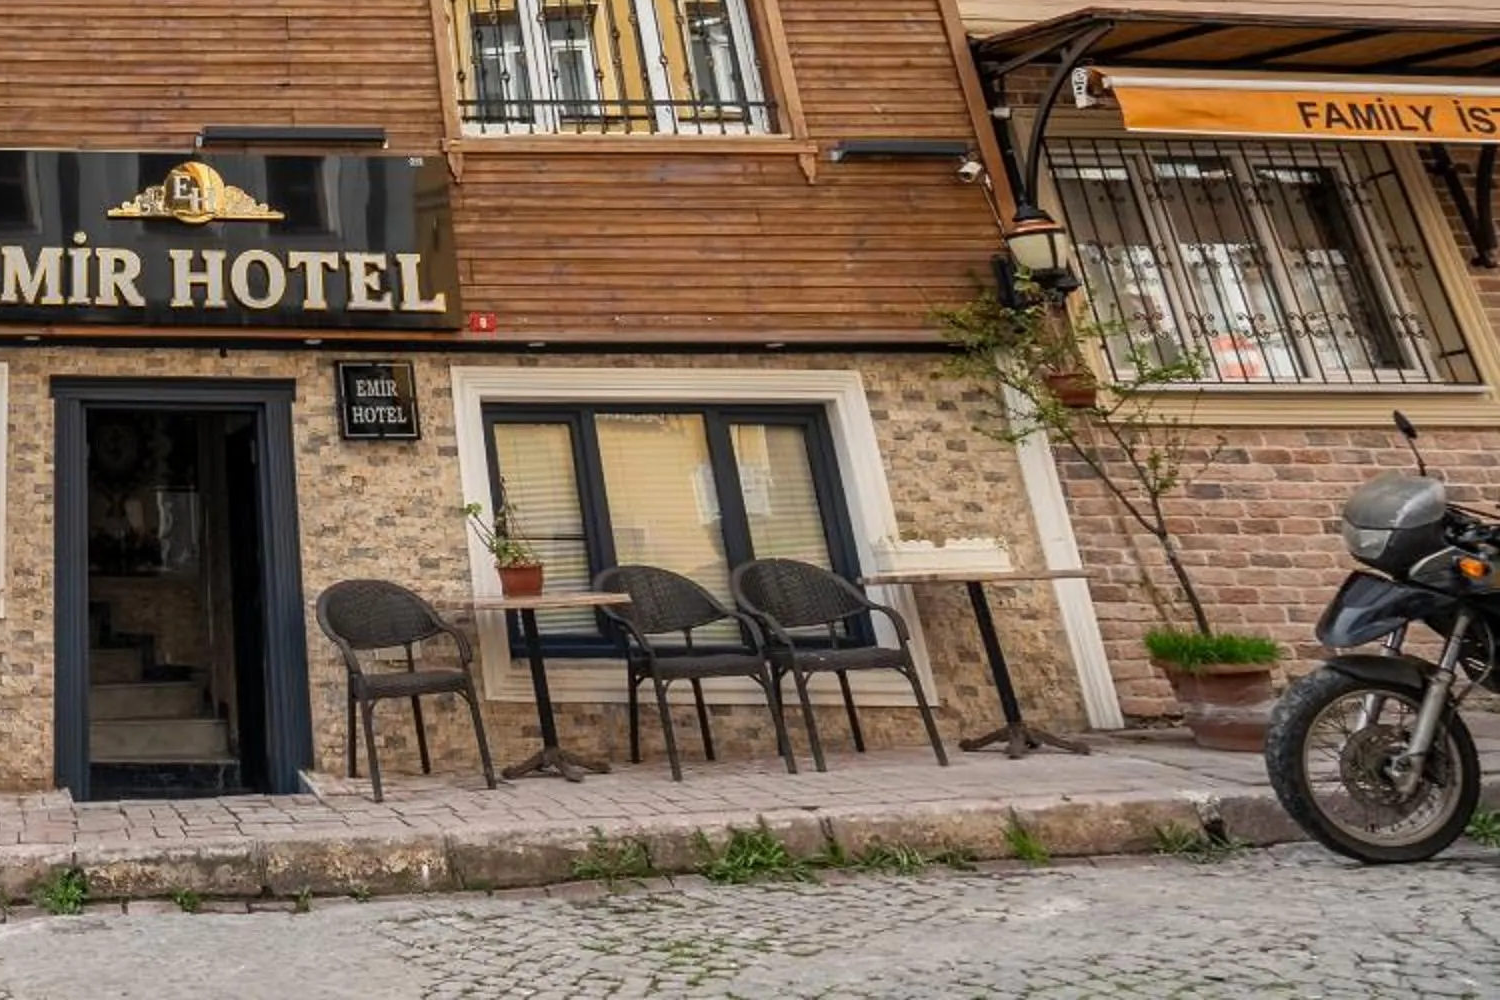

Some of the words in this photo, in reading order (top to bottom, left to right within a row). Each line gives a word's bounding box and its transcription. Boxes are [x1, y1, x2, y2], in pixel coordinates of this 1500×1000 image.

[1297, 97, 1434, 132] FAMİLY
[1452, 99, 1500, 134] İS
[169, 249, 447, 313] HOTEL
[351, 405, 407, 424] HOTEL
